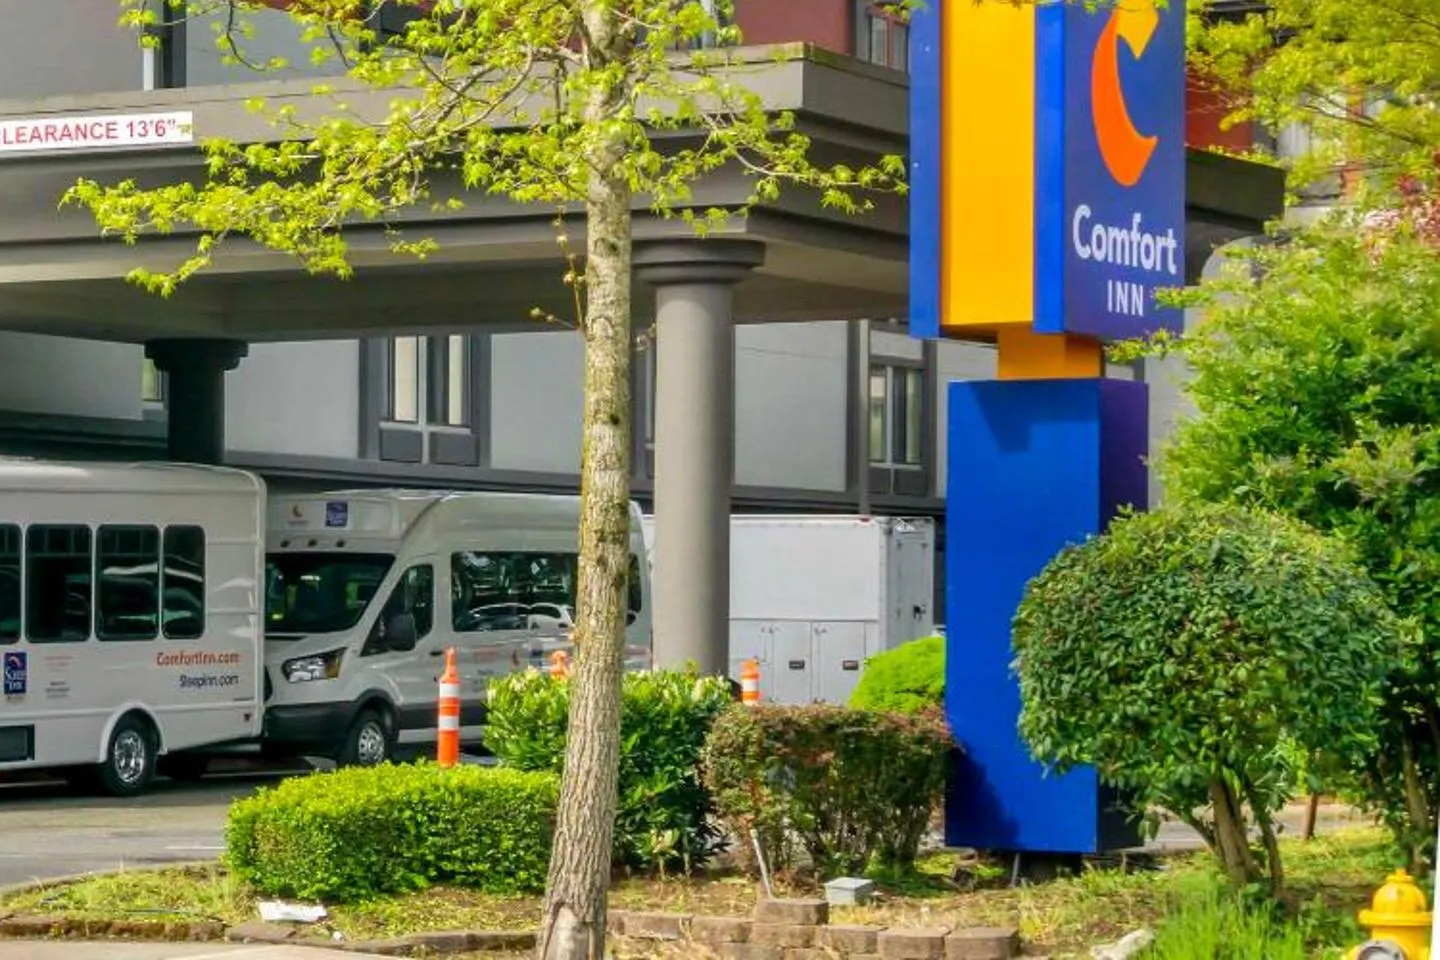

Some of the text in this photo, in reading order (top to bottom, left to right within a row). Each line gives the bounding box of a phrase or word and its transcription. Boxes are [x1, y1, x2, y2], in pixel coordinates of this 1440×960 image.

[126, 118, 176, 138] 13'6"
[1072, 204, 1177, 275] Comfort
[1106, 279, 1144, 317] INN
